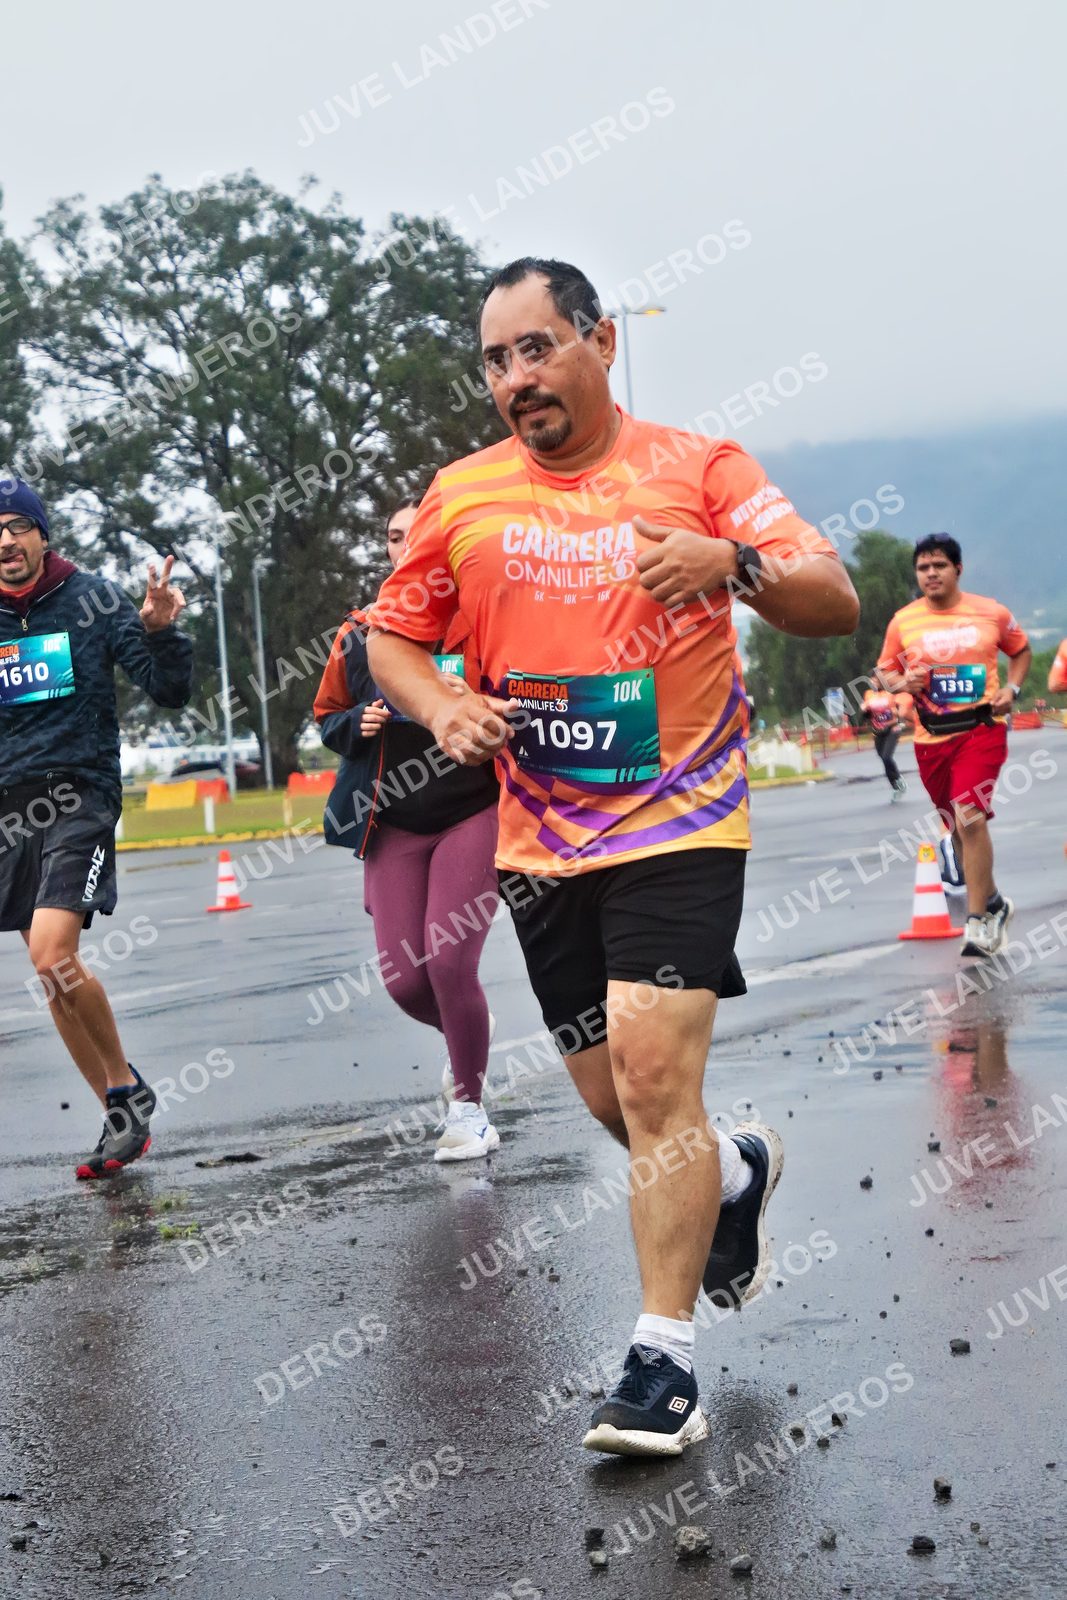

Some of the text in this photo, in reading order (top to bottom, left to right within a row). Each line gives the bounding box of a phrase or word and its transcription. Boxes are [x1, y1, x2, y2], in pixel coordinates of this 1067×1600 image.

[502, 521, 636, 563] CARRERA
[505, 559, 607, 589] OMNILIFE
[43, 639, 61, 653] 10K
[0, 662, 49, 687] 1610
[441, 659, 458, 673] 10K
[508, 680, 568, 700] CARRERA
[613, 679, 643, 703] 10K
[940, 679, 974, 693] 1313
[510, 697, 555, 712] MNILIFE
[530, 717, 617, 751] 1097
